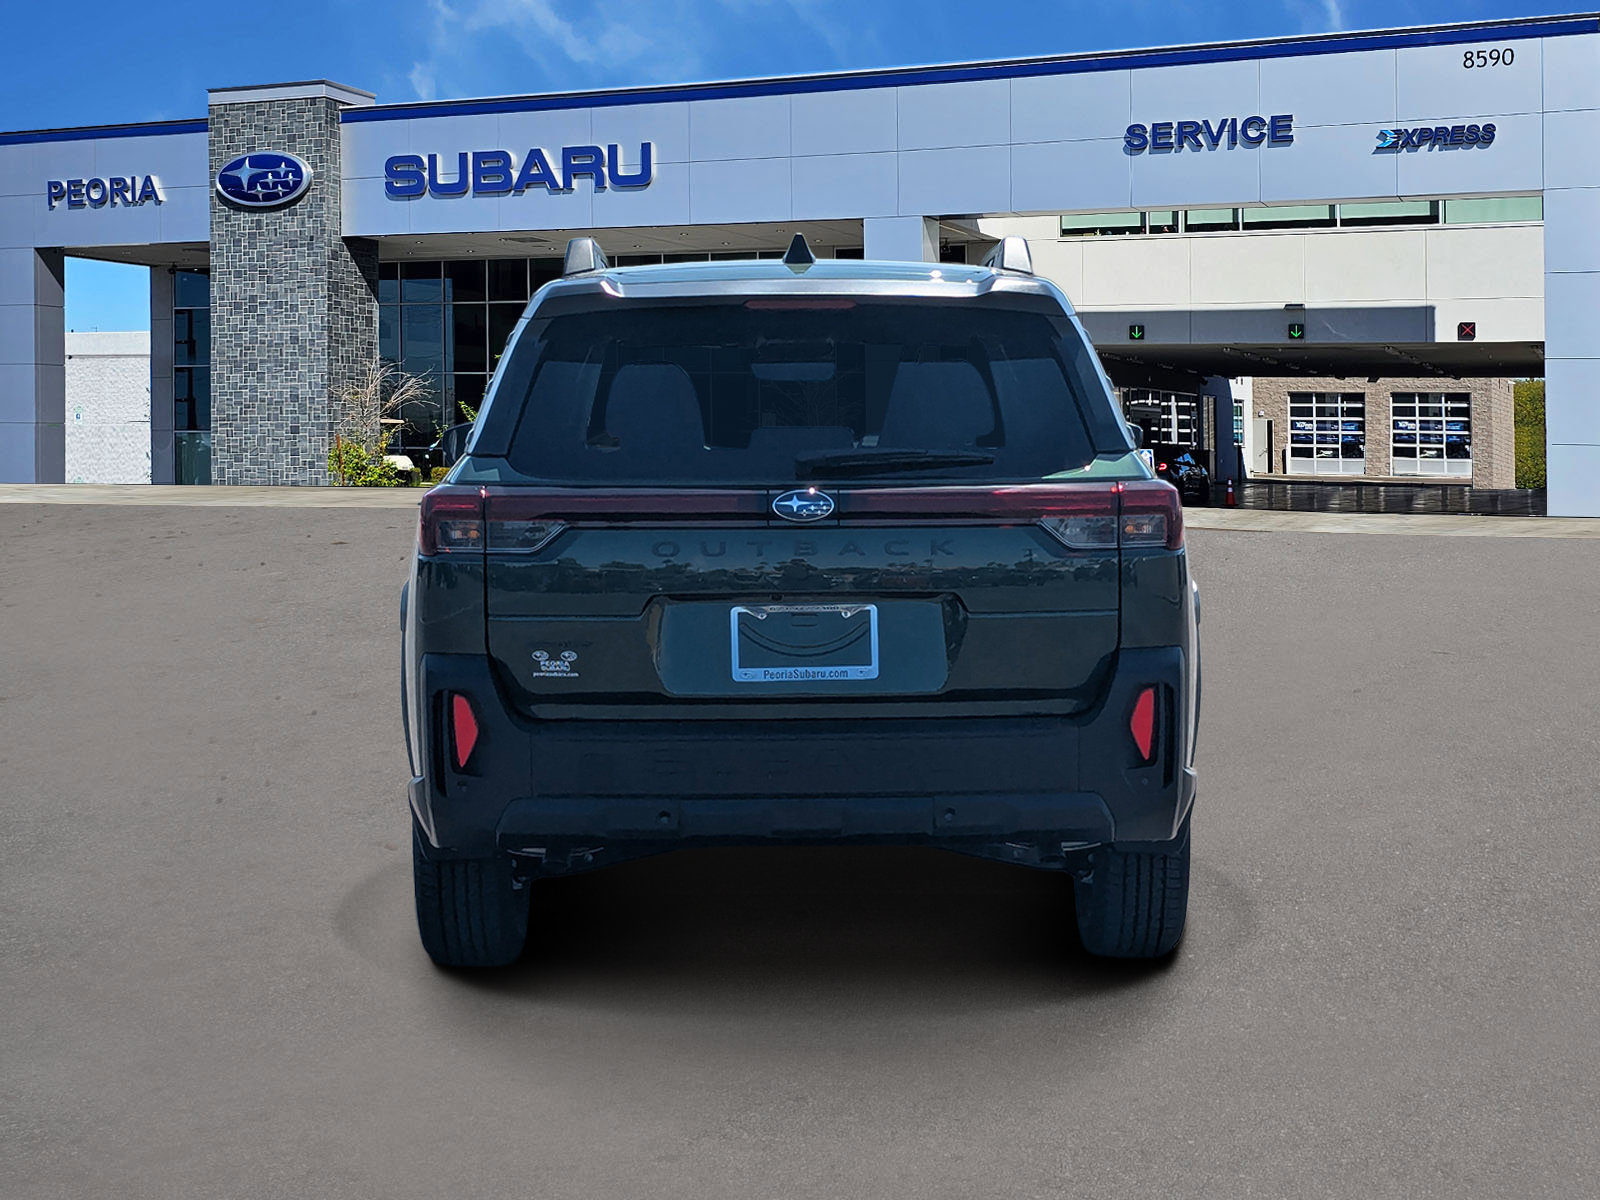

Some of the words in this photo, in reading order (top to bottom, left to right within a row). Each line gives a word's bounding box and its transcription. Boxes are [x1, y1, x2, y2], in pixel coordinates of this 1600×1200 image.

[1463, 48, 1515, 69] 8590
[1125, 114, 1294, 151] SERVICE
[1375, 123, 1497, 150] EXPRESS
[384, 142, 652, 198] SUBARU
[47, 175, 162, 208] PEORIA
[651, 541, 955, 558] OUTBACK
[763, 669, 849, 680] PeoriaSubaru.com
